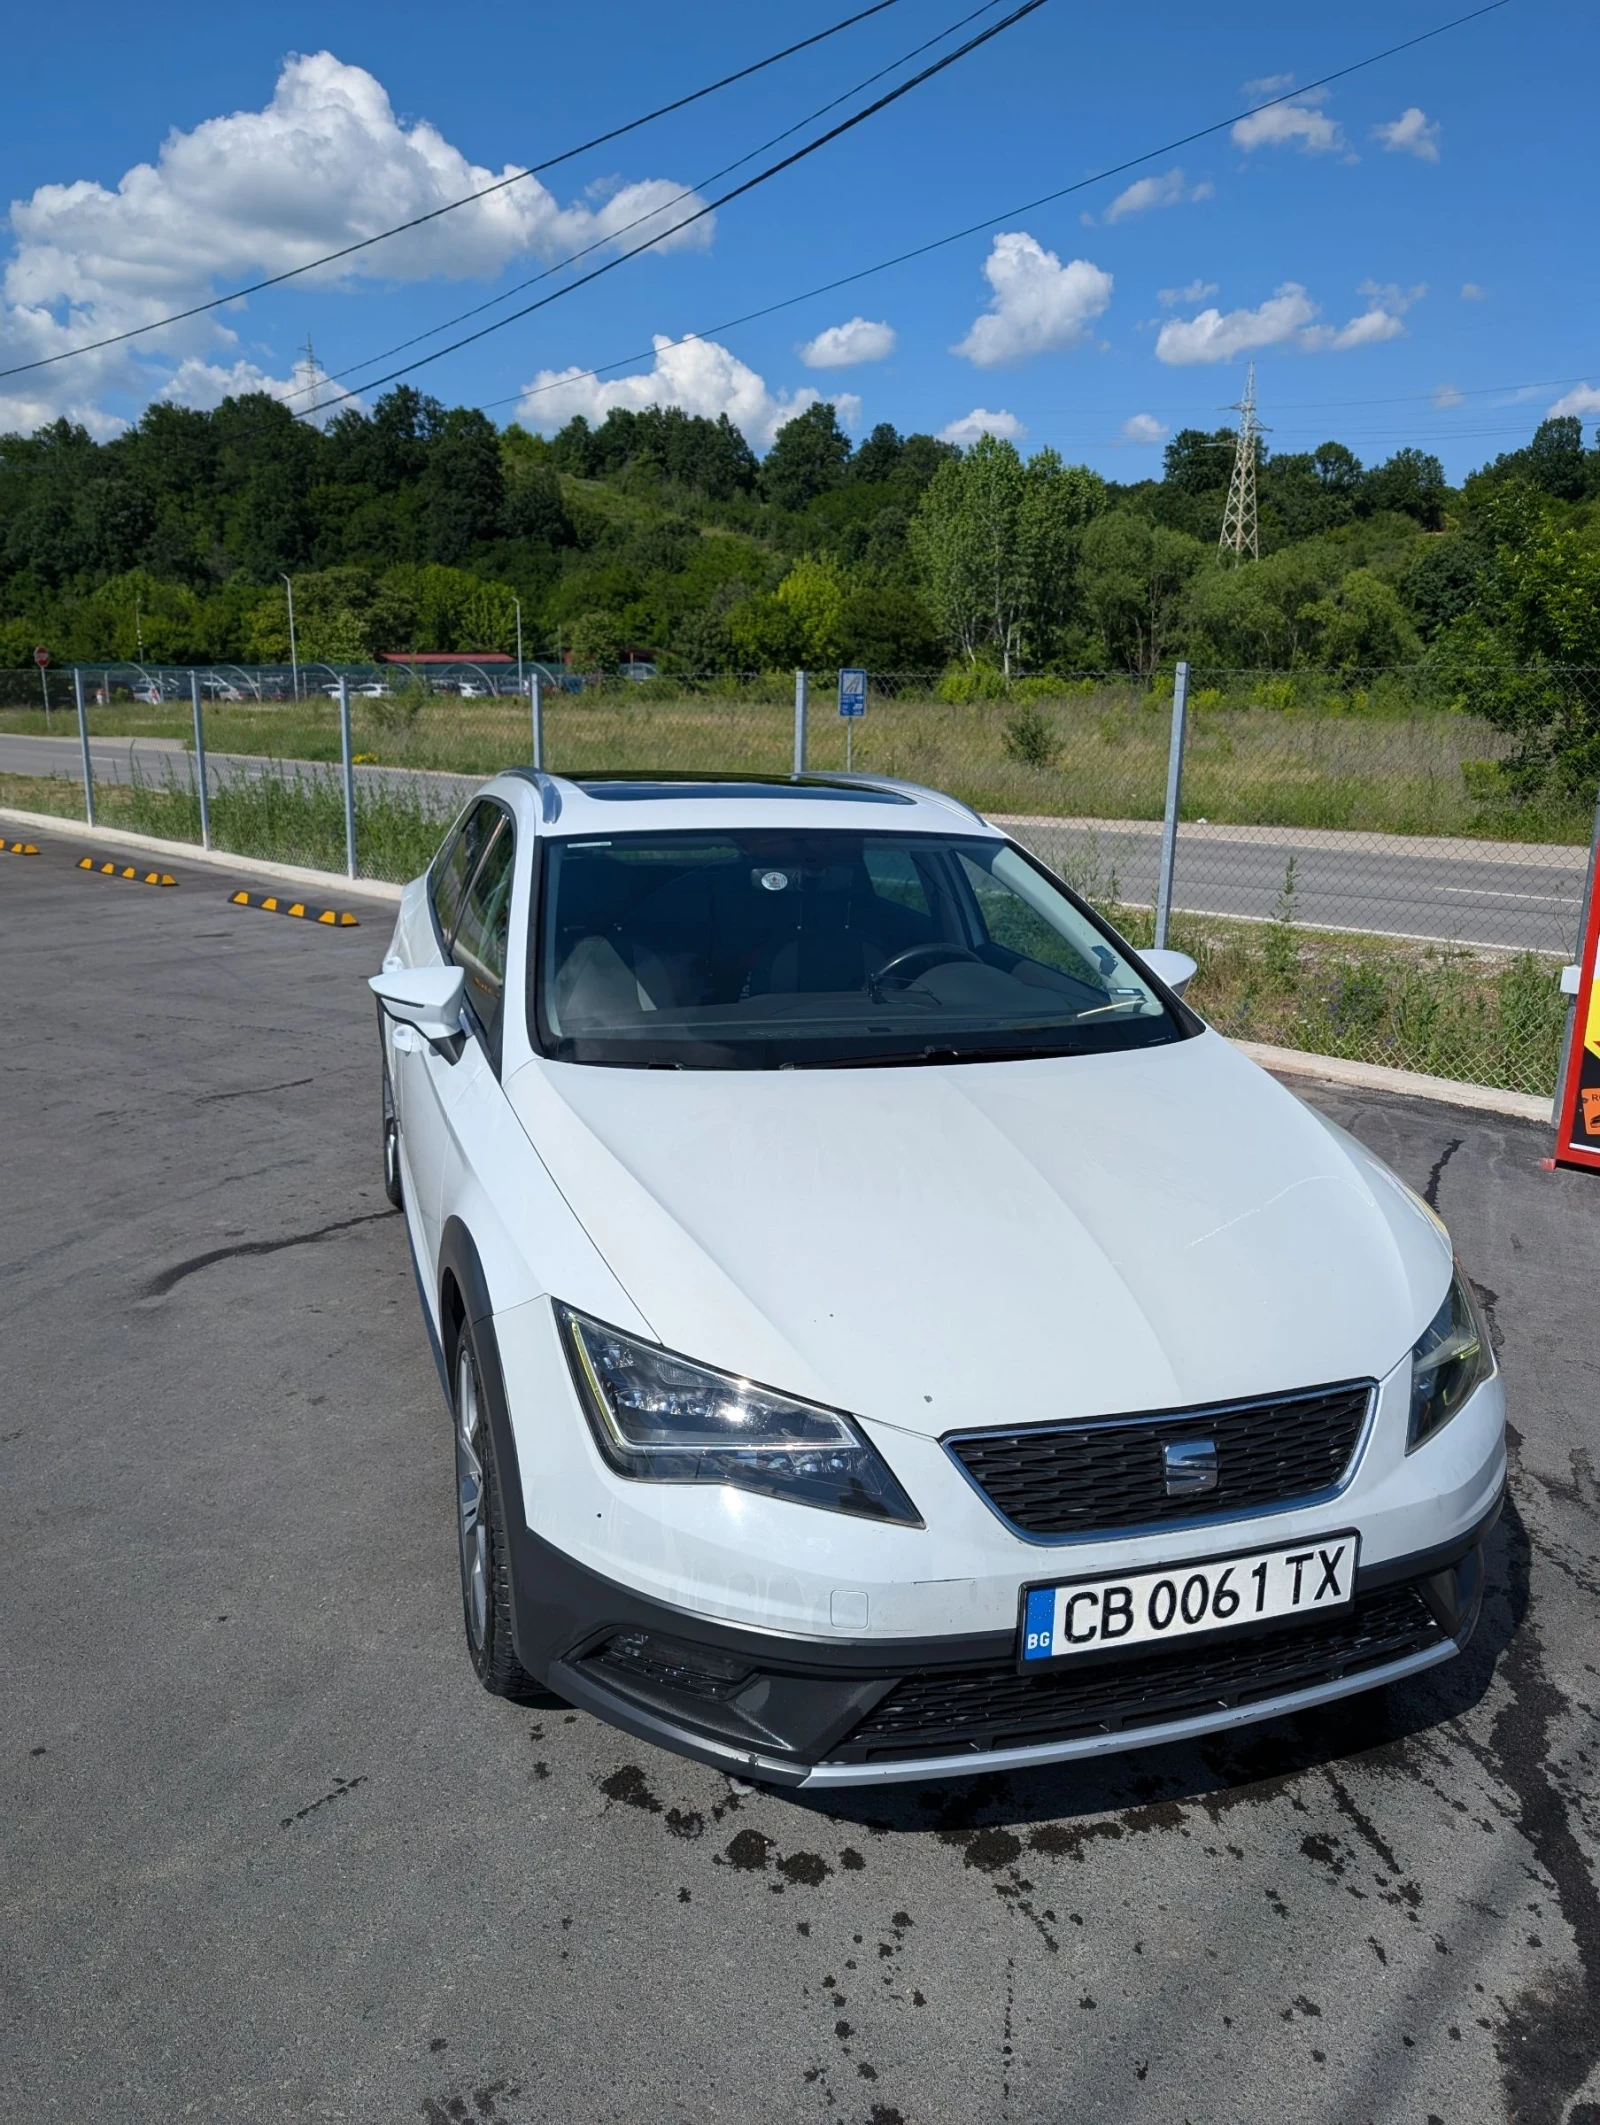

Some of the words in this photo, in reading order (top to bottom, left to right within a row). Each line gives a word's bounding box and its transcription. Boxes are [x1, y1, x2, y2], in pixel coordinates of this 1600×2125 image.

[1064, 1587, 1133, 1645] CB
[1149, 1561, 1268, 1630] 0061
[1286, 1545, 1346, 1605] TX
[1027, 1632, 1050, 1649] BG
